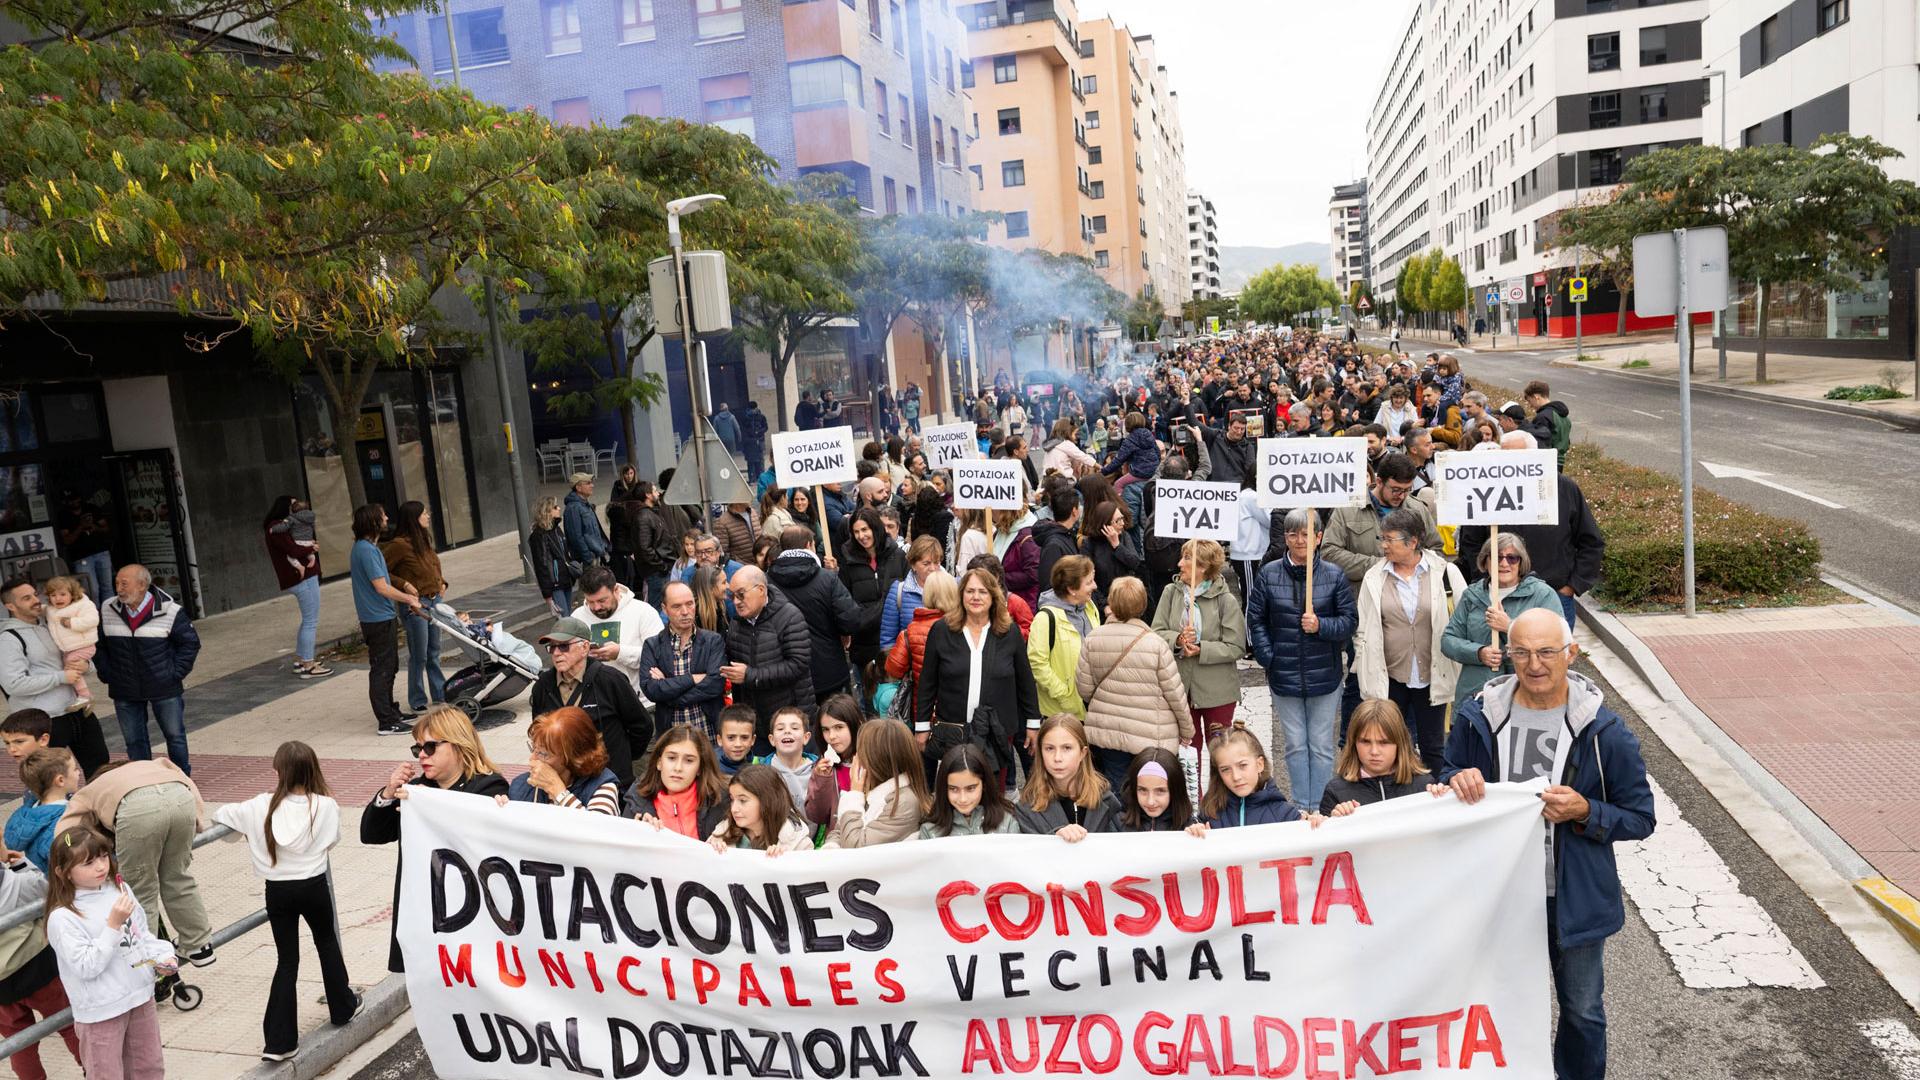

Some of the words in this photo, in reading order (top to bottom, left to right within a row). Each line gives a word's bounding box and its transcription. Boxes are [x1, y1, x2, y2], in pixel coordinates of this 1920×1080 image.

[927, 431, 968, 443] DOTACIONES
[788, 440, 842, 455] DOTAZIOAK
[938, 444, 963, 465] ¡YA!
[790, 453, 844, 474] ORAIN!
[1268, 451, 1354, 466] DOTAZIOAK
[959, 470, 1015, 480] DOTAZIOAK
[1445, 464, 1544, 481] DOTACIONES
[959, 484, 1016, 501] ORAIN!
[1157, 485, 1238, 502] DOTACIONES
[1268, 472, 1355, 495] ORAIN!
[1466, 485, 1524, 519] ¡YA!
[1172, 506, 1220, 533] ¡YA!
[0, 534, 44, 554] AB
[431, 849, 894, 954] DOTACIONES
[936, 851, 1372, 943] CONSULTA
[438, 941, 907, 1007] MUNICIPALES
[946, 934, 1271, 1002] VECINAL
[453, 1013, 605, 1079] UDAL
[607, 1017, 931, 1080] DOTAZIOAK
[961, 1014, 1123, 1076] AUZO
[1133, 1004, 1507, 1080] GALDEKETA
